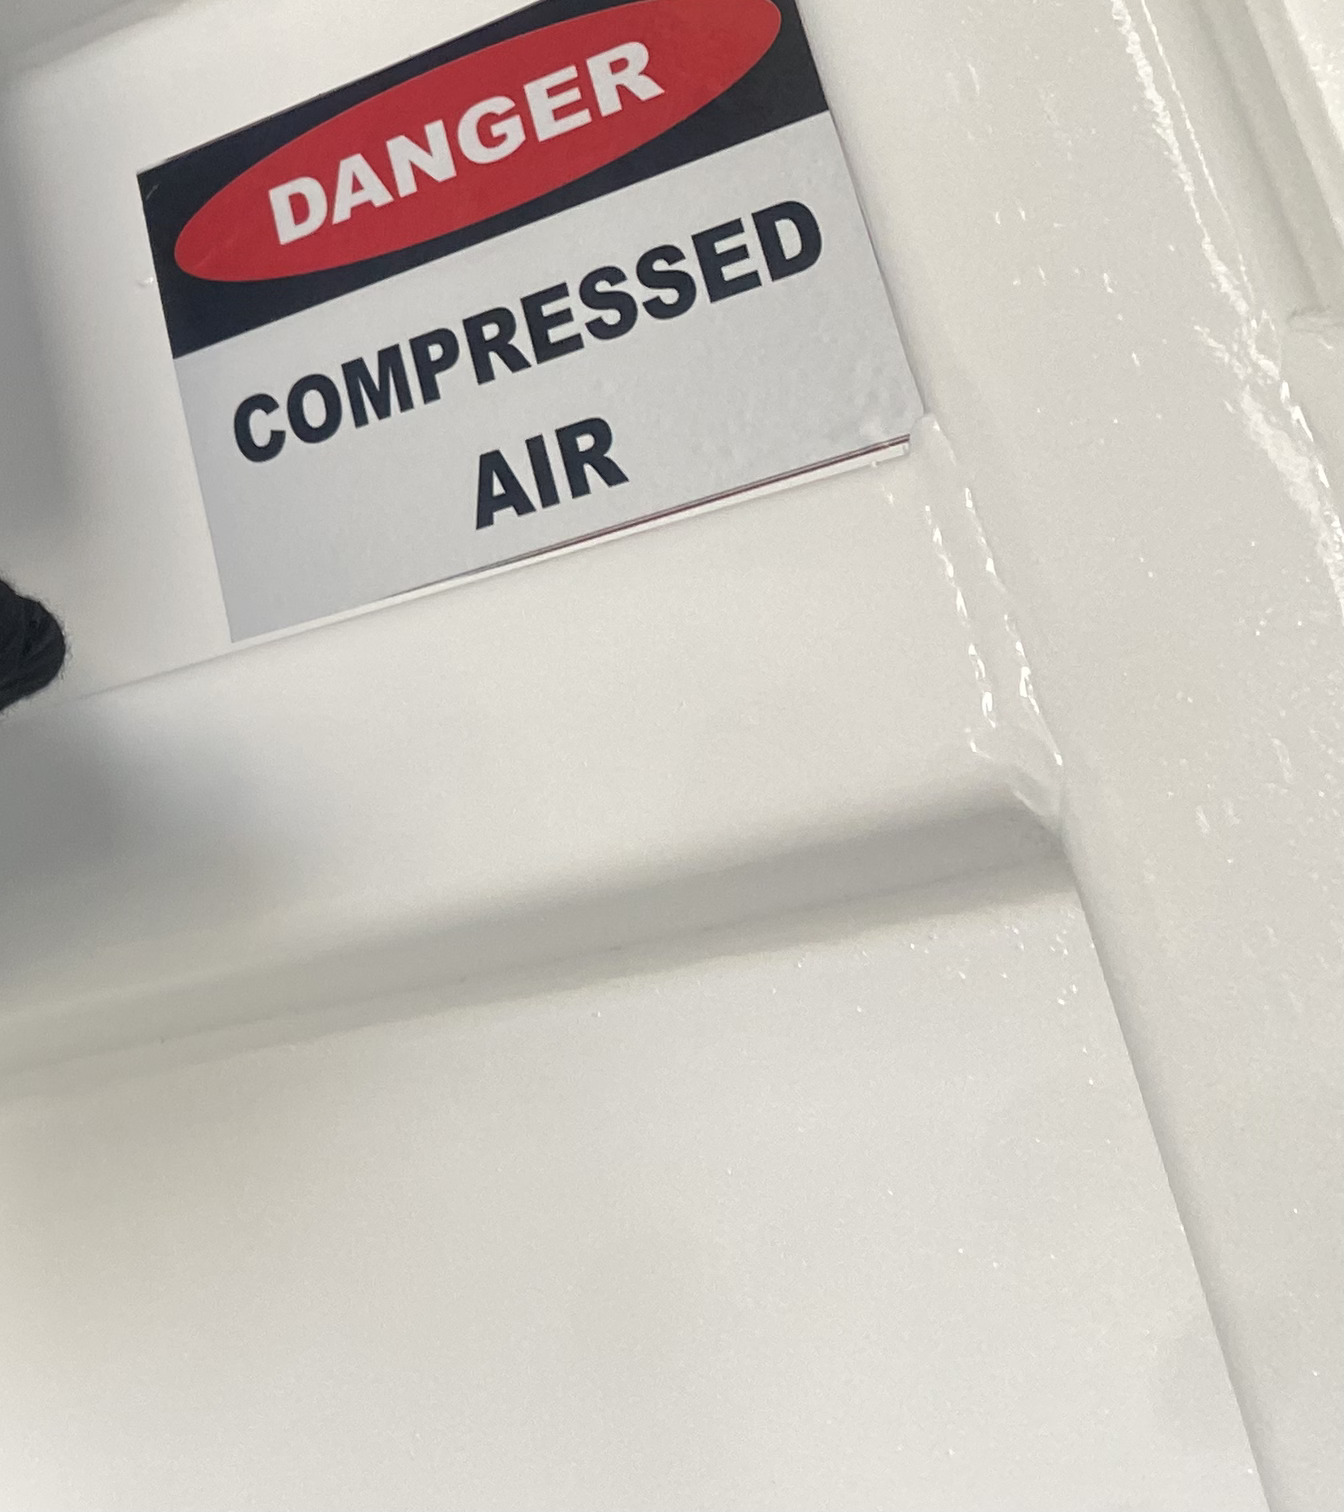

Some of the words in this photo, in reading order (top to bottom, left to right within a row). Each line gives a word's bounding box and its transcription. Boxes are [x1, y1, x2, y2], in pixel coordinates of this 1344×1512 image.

[268, 41, 664, 246] DANGER
[233, 200, 824, 463] COMPRESSED
[475, 417, 629, 530] AIR
